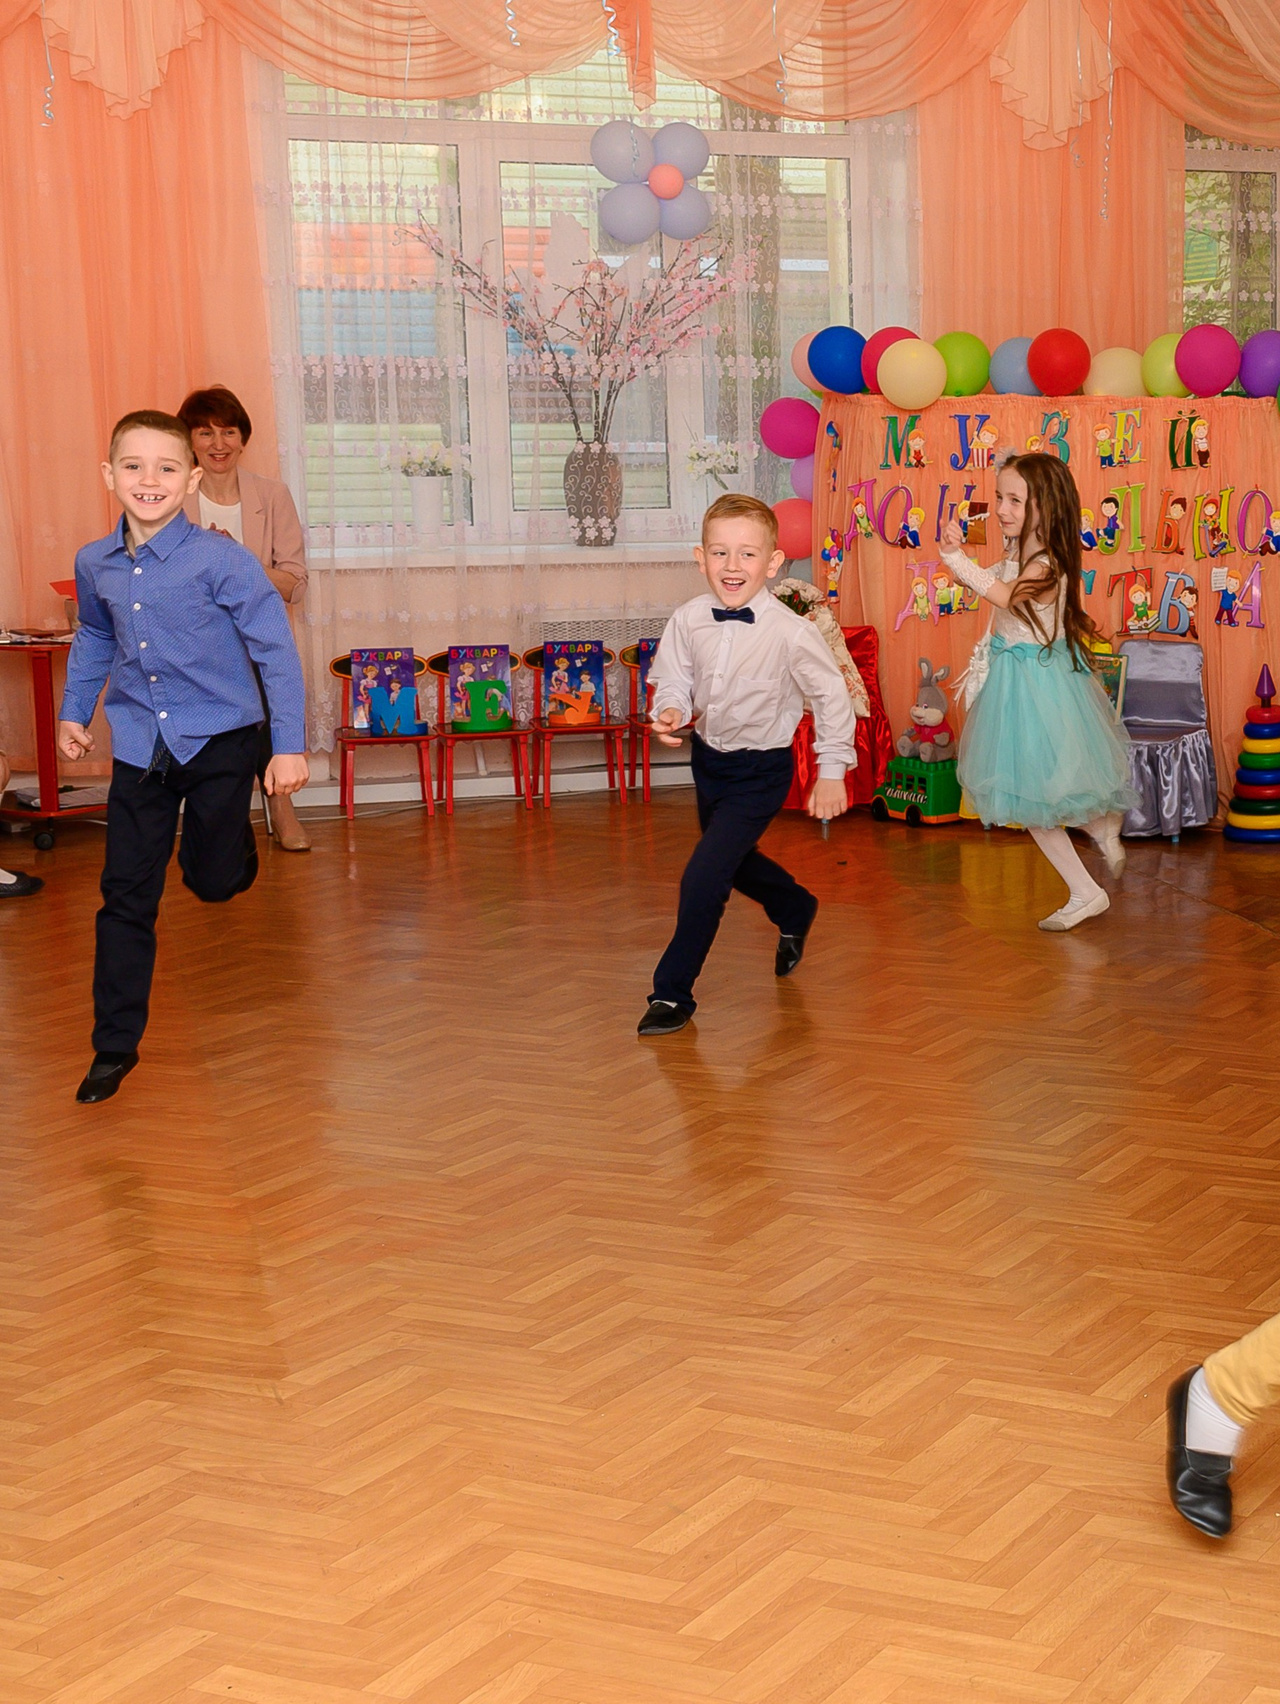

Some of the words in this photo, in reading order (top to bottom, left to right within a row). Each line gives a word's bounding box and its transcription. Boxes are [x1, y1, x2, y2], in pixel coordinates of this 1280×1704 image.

[880, 408, 1205, 471] МУЗЕЙ
[451, 648, 505, 659] БУКВАРЬ
[546, 643, 599, 654] БУКВАРЬ
[353, 651, 409, 662] БУКВАРЬ
